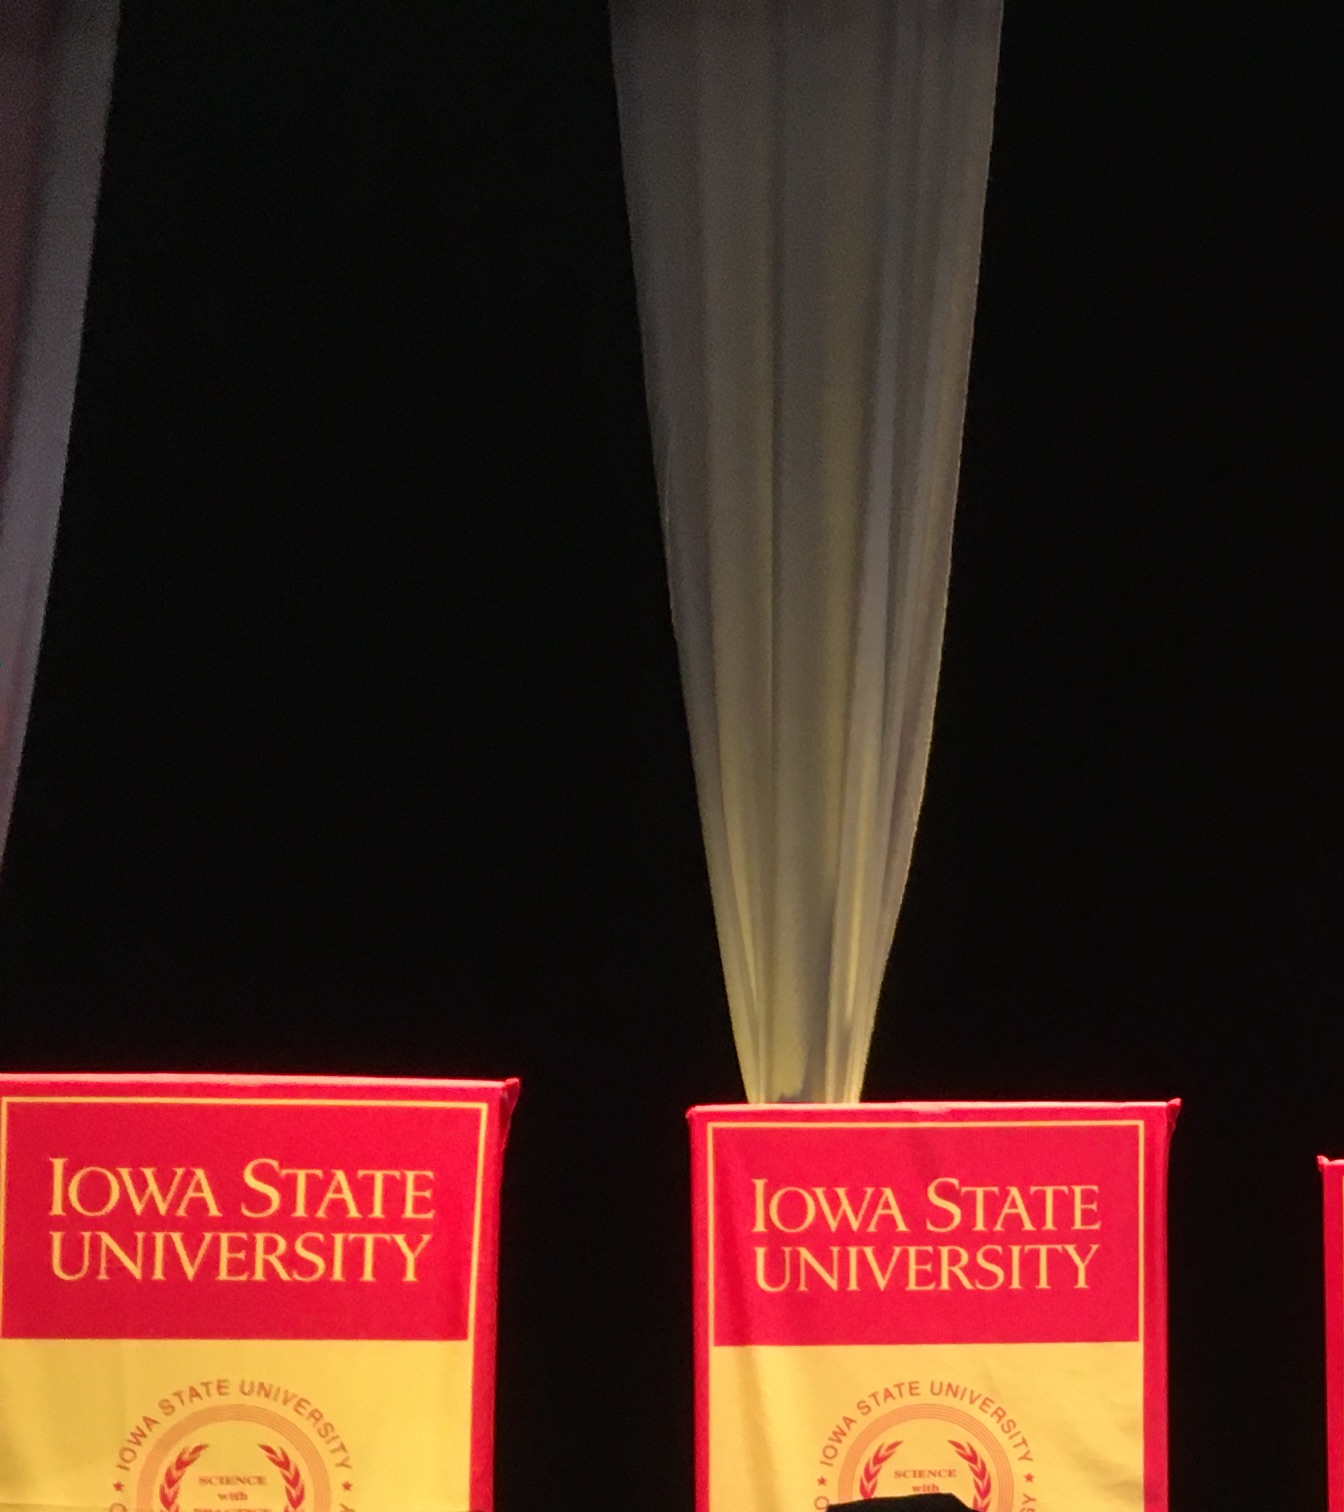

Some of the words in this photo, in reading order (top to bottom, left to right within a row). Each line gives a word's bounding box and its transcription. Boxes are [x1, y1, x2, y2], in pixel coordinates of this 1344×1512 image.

[50, 1158, 222, 1216] IOWA
[242, 1159, 434, 1219] STATE
[752, 1179, 908, 1232] IOWA
[927, 1178, 1100, 1232] STATE
[51, 1232, 431, 1282] UNIVERSITY
[755, 1245, 1098, 1292] UNIVERSITY
[116, 1415, 160, 1471] IOWA
[158, 1378, 229, 1416] STATE
[239, 1380, 353, 1470] UNIVERSITY
[819, 1415, 857, 1467] IOWA
[856, 1380, 920, 1416] STATE
[929, 1380, 1034, 1462] UNIVERSITY
[894, 1469, 957, 1479] SCIENCE
